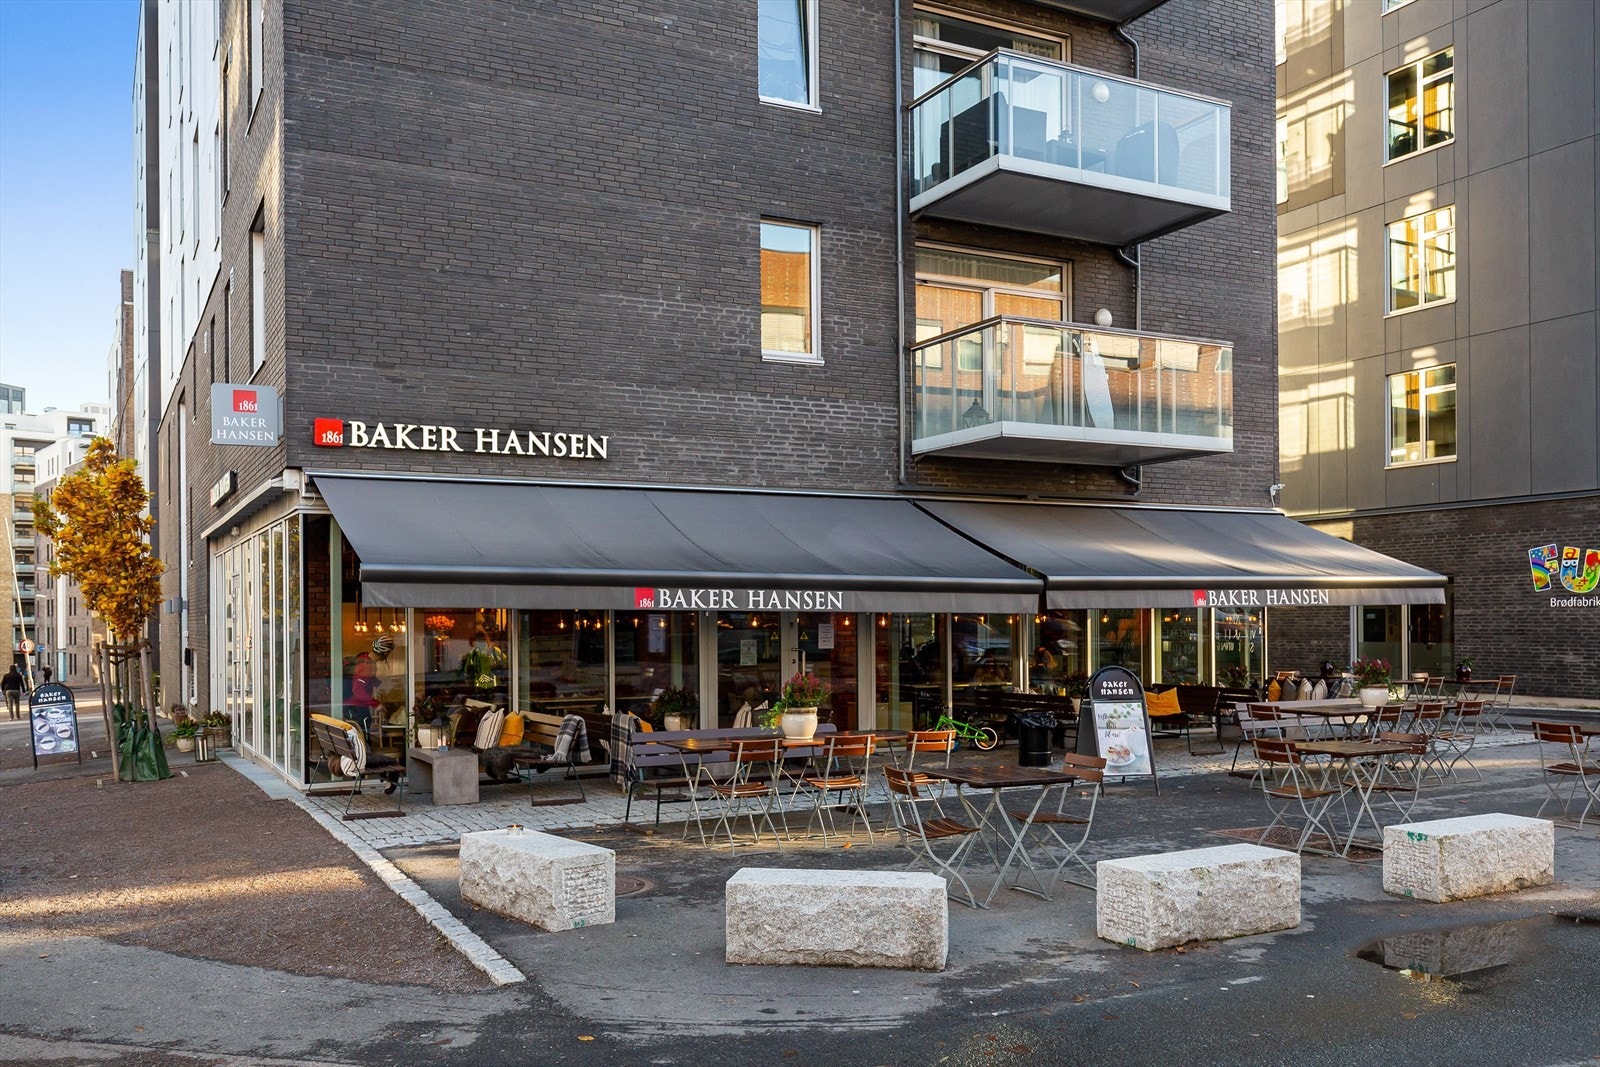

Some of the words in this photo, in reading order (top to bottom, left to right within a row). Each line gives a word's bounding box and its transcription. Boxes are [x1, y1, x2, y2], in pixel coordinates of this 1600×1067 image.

[239, 401, 257, 411] 1861
[223, 416, 267, 428] BAKER
[217, 429, 274, 441] HANSEN
[321, 430, 343, 444] 1861
[348, 420, 464, 452] BAKER
[474, 427, 609, 459] HANSEN
[639, 599, 655, 608] 1861
[657, 588, 738, 609] BAKER
[747, 589, 843, 610] HANSEN
[1208, 589, 1261, 606] BAKER
[1266, 589, 1329, 606] HANSEN
